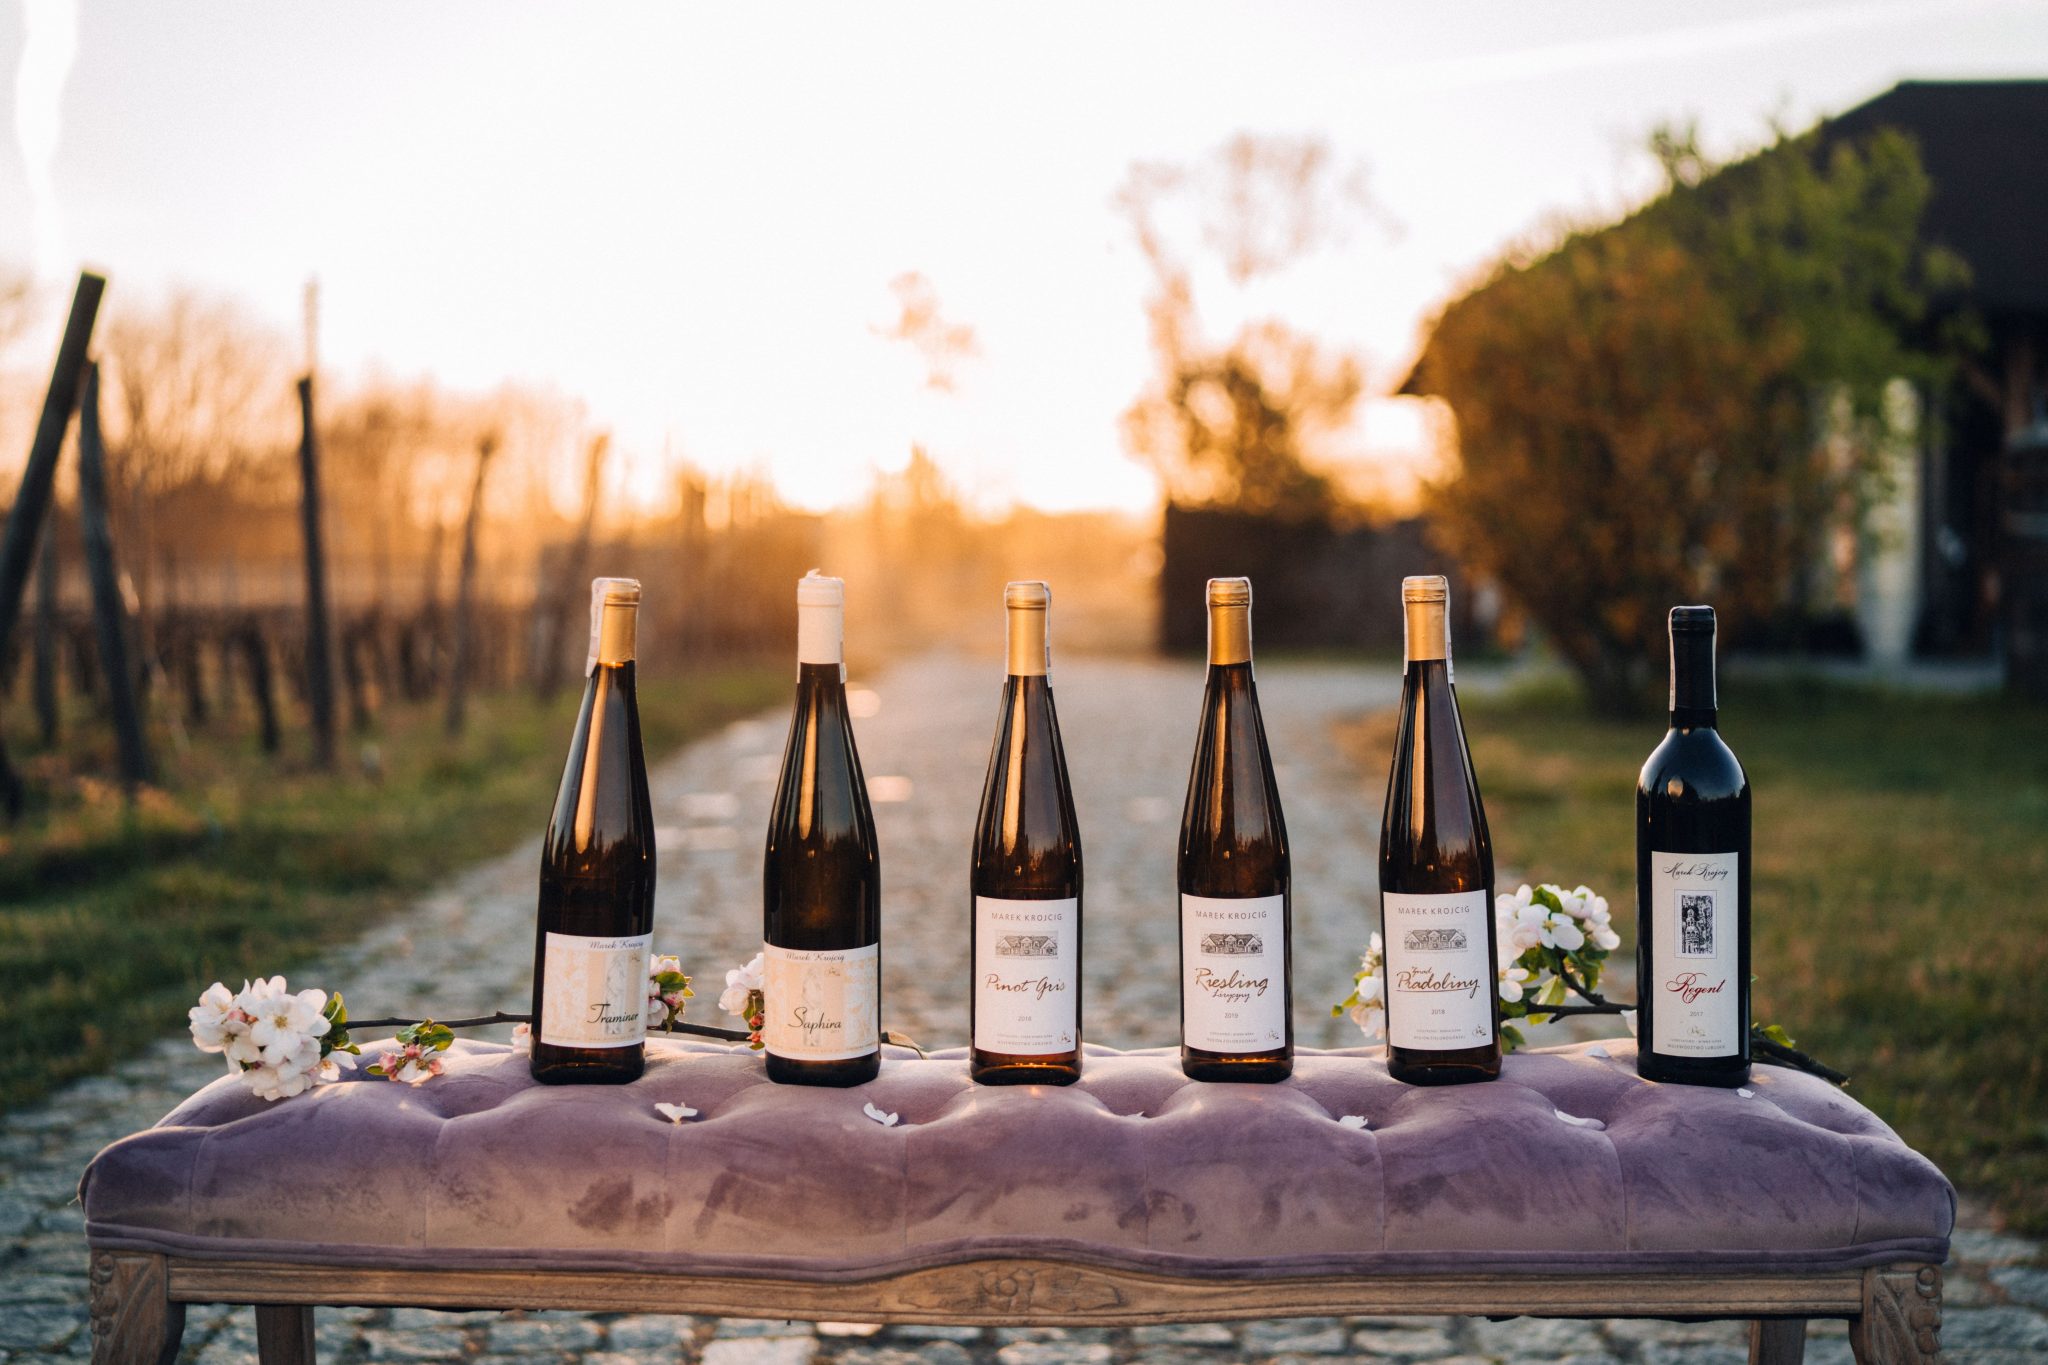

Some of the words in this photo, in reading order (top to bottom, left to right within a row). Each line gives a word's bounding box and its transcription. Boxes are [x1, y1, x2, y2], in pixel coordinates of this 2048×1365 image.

[991, 912, 1021, 921] MAREK
[1025, 913, 1063, 921] KROJCIG
[1195, 910, 1225, 920] MAREK
[1228, 911, 1267, 920] KROJCIG
[1398, 907, 1427, 915] MAREK
[1430, 905, 1470, 915] KROJCIG
[985, 973, 1036, 993] Pinot
[1035, 976, 1066, 1001] Gris
[1195, 967, 1269, 997] Riesling
[1396, 972, 1480, 999] Pradoliny
[1666, 972, 1726, 1004] Regent
[587, 1003, 639, 1024] Traminer
[788, 1006, 842, 1034] Saphira
